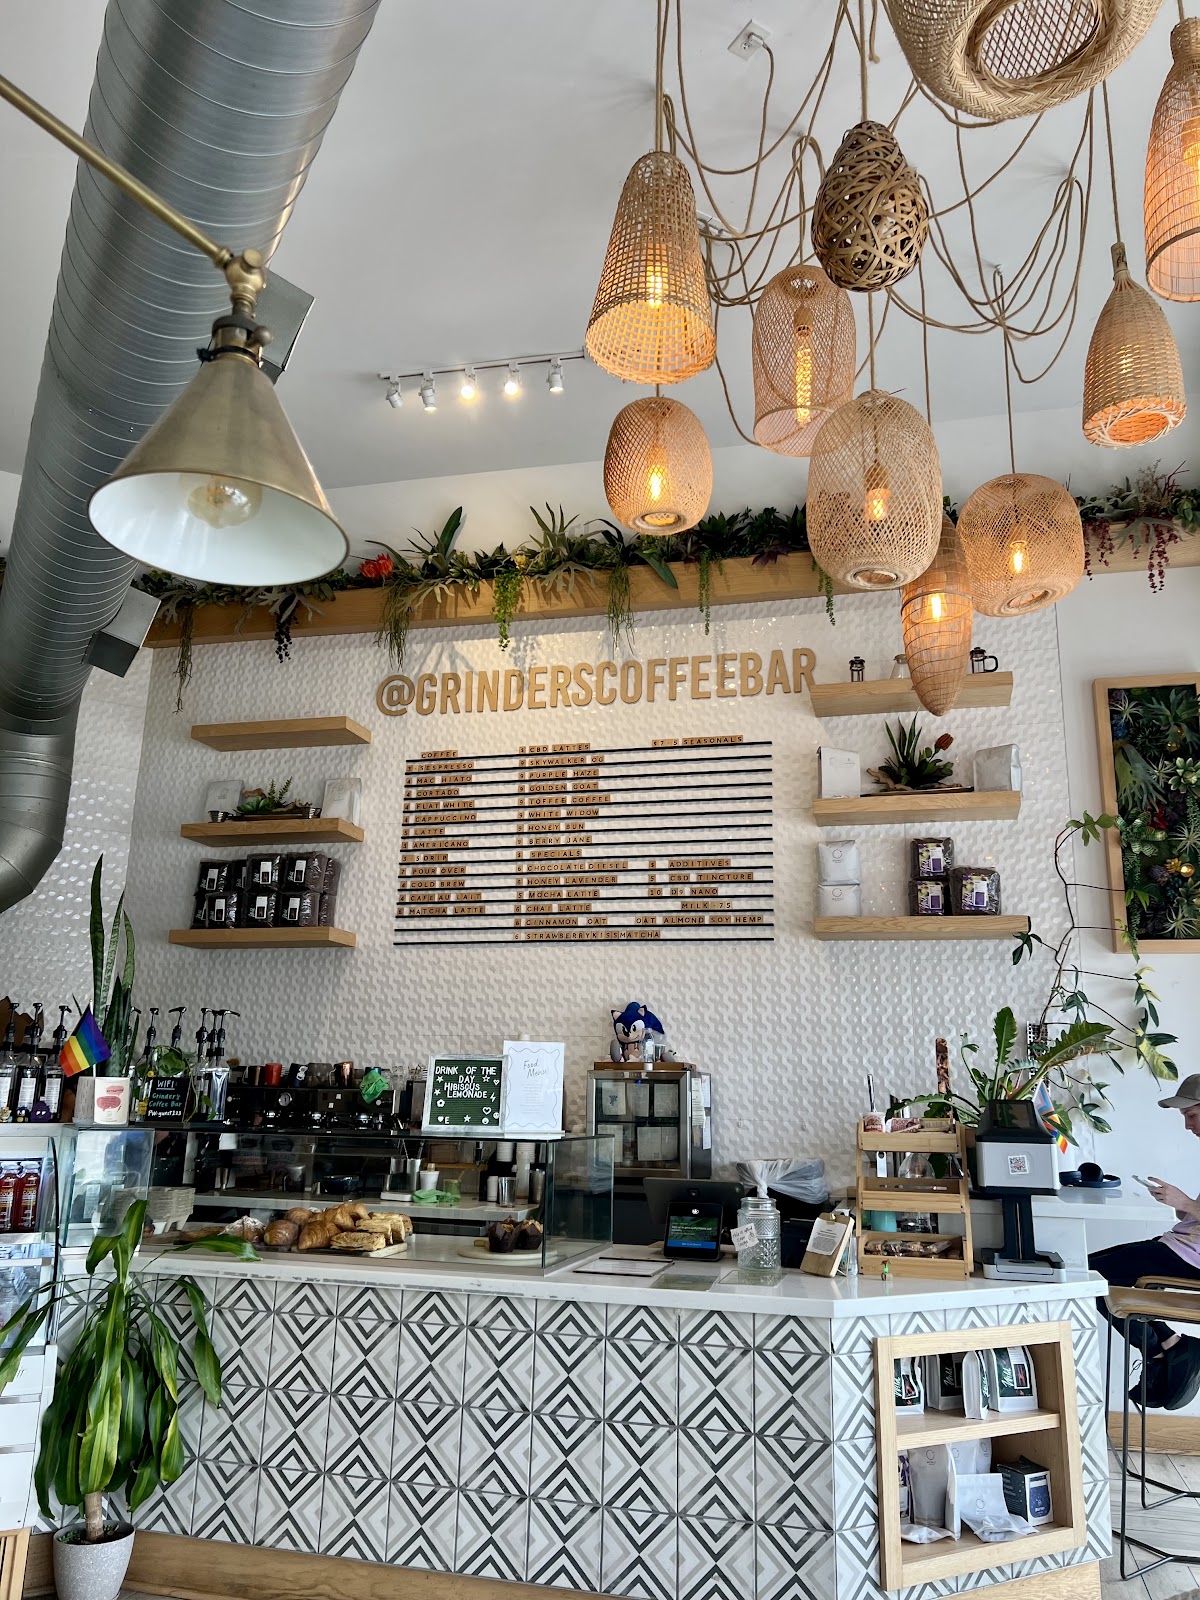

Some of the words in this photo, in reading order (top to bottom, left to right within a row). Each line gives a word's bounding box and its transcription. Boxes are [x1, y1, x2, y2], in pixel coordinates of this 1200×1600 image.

[376, 647, 816, 717] @GRINDERSCOFFEEBAR
[683, 737, 742, 745] SEASONALS
[553, 744, 589, 752] LATTES
[421, 751, 457, 759] COFFEE
[530, 757, 585, 766] SKYWALKER
[416, 789, 459, 797] CORTADO
[415, 814, 476, 822] CAPPUCCINO
[435, 1066, 459, 1075] DRINK
[465, 1066, 478, 1074] OF
[480, 1066, 497, 1075] THE
[458, 1075, 476, 1084] DAY
[444, 1082, 480, 1091] HIBISCUS
[447, 1090, 488, 1098] LEMONADE
[444, 1116, 450, 1124] E
